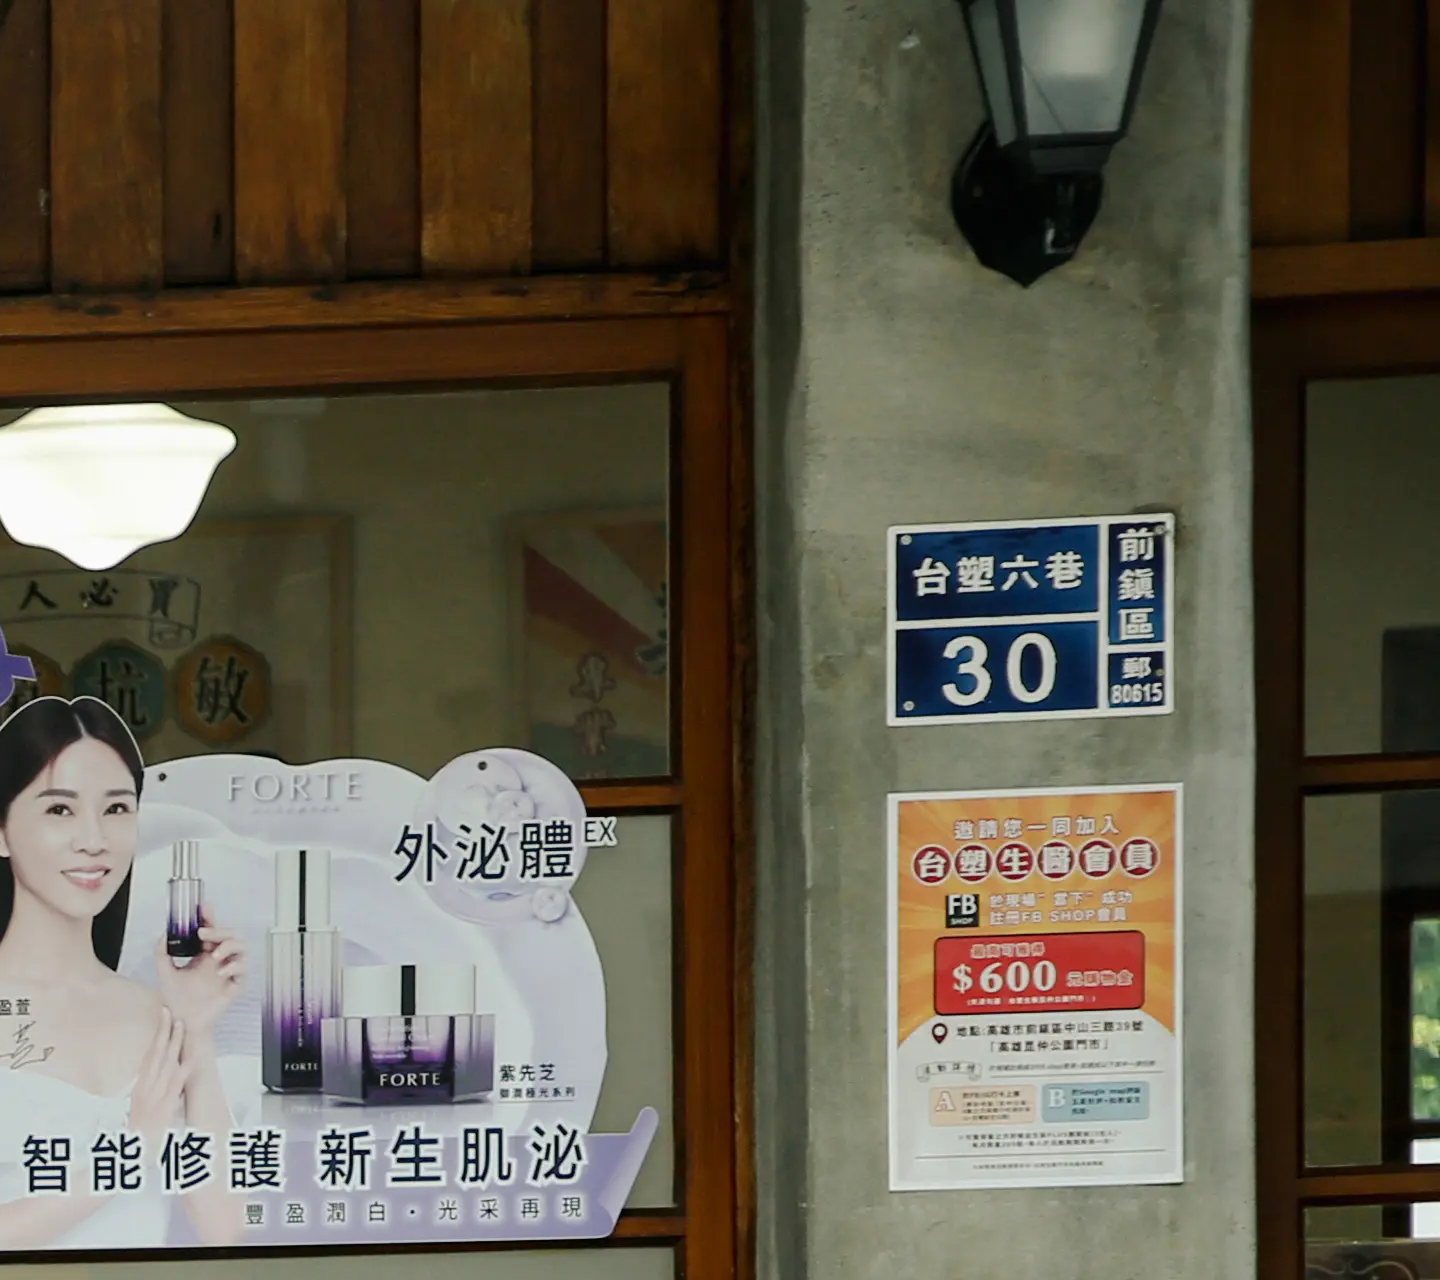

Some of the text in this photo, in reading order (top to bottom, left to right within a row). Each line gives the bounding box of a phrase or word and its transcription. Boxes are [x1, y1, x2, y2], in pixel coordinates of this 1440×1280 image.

[913, 552, 1085, 598] 台塑六巷
[1117, 528, 1156, 642] 前鎮區
[941, 632, 1058, 706] 30
[1121, 656, 1151, 680] 郵
[1111, 682, 1163, 706] 80615
[228, 772, 362, 801] FORTE
[954, 815, 1120, 840] 邀請您一同加入
[917, 843, 1155, 879] 台塑生醫會員
[948, 894, 978, 916] FB
[950, 917, 974, 926] SHOP
[952, 960, 1056, 993] $600
[284, 1062, 319, 1071] FORTE
[499, 1064, 556, 1082] 紫先芝
[380, 1072, 441, 1087] FORTE
[21, 1124, 584, 1192] 智能修護 新生肌泌
